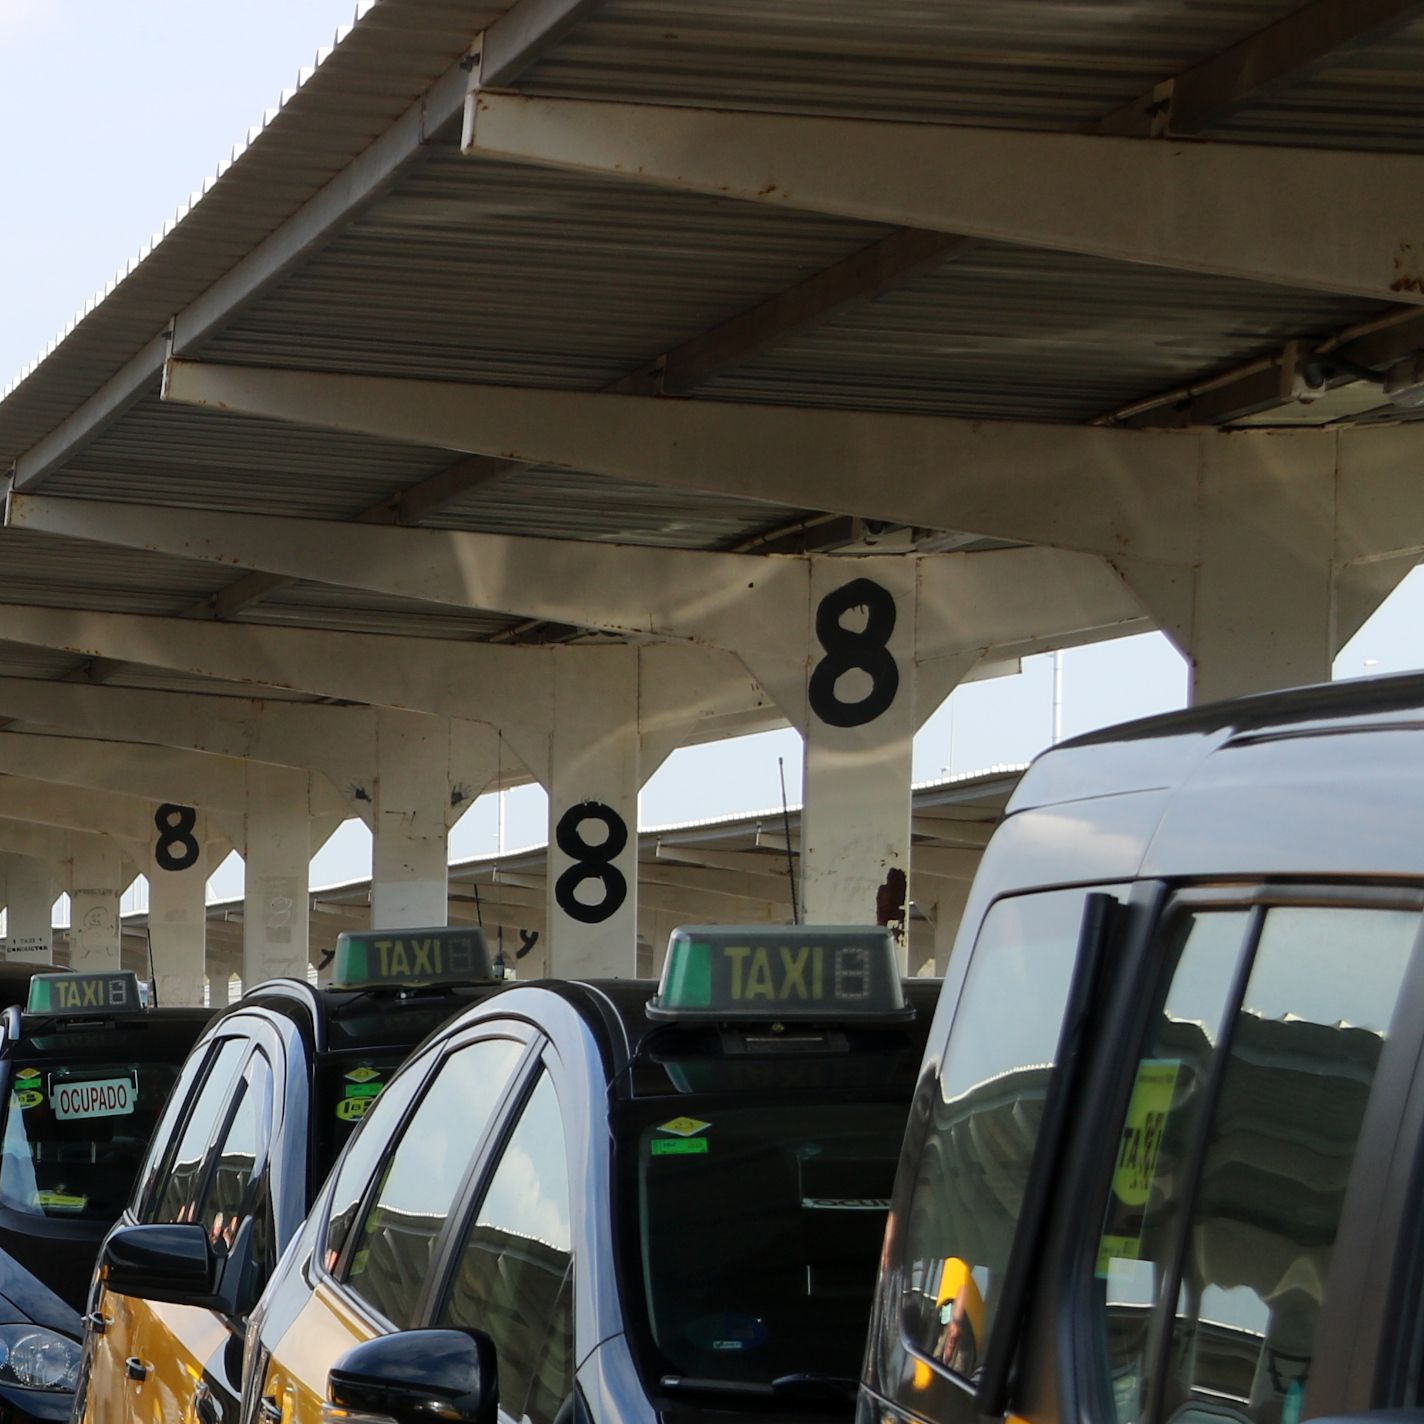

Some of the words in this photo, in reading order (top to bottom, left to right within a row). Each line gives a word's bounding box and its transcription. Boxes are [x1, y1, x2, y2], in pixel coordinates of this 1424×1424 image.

[808, 577, 899, 728] 8
[155, 803, 200, 871] 8
[555, 801, 628, 924] 8
[375, 939, 442, 977] TAXI
[725, 945, 823, 1001] TAXI
[56, 980, 104, 1008] TAXI
[60, 1083, 128, 1114] OCUPADO
